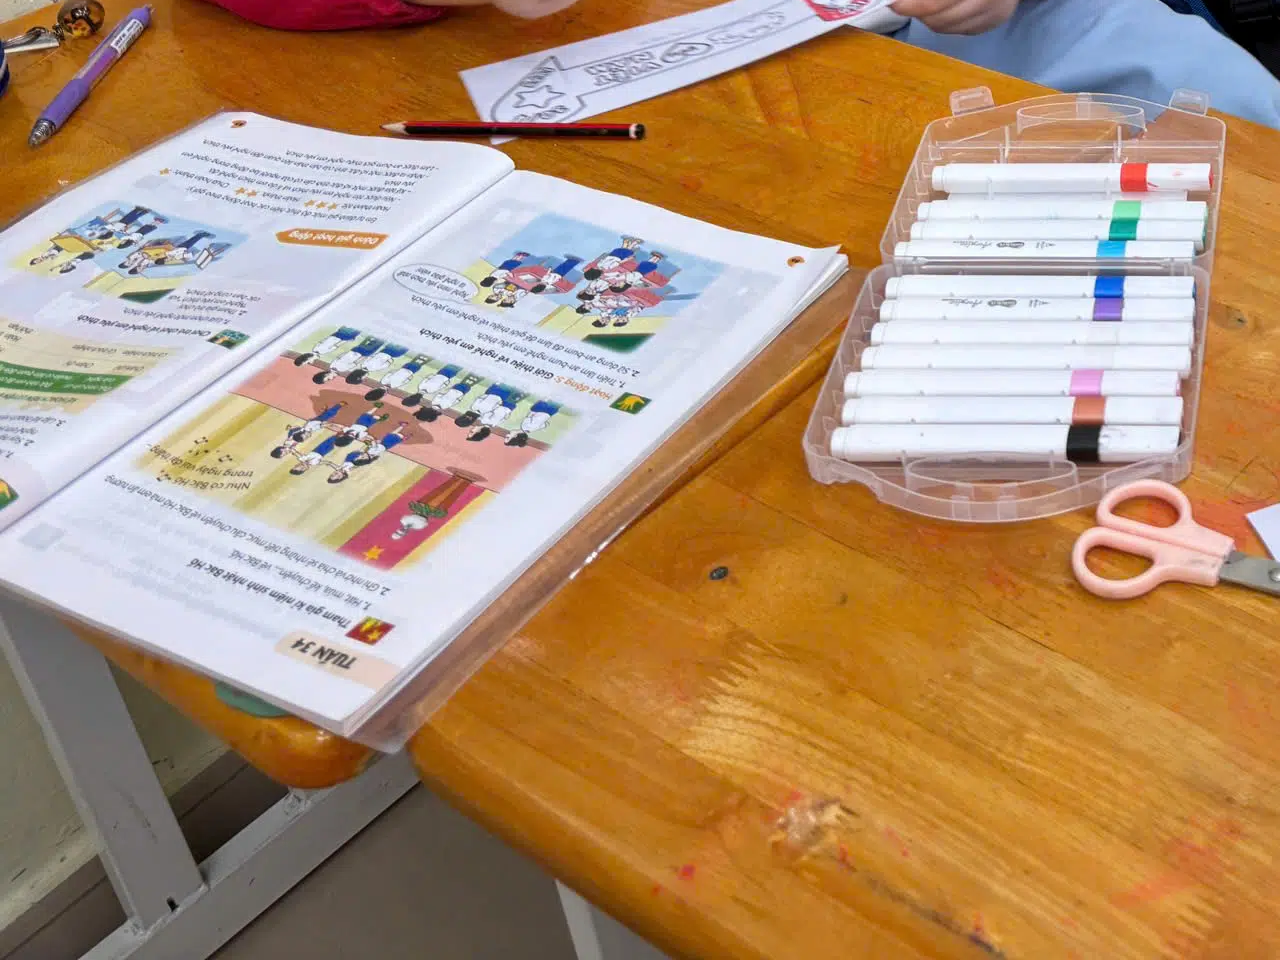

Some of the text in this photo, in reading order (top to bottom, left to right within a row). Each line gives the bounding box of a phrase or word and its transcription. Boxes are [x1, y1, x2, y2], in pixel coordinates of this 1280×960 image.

[444, 307, 460, 316] em
[418, 327, 443, 341] thích
[442, 335, 460, 345] yêu
[459, 341, 475, 350] em
[470, 346, 499, 360] nghề
[512, 345, 528, 354] em
[563, 347, 597, 363] an-bum
[494, 355, 510, 364] về
[548, 357, 581, 372] an-bum
[532, 368, 555, 380] Giới
[631, 369, 640, 378] 2.
[618, 379, 627, 389] 1.
[222, 468, 254, 478] trong
[206, 563, 225, 577] Bác
[246, 580, 270, 594] sinh
[305, 605, 324, 615] gia
[322, 610, 352, 629] Tham
[291, 638, 316, 654] 34
